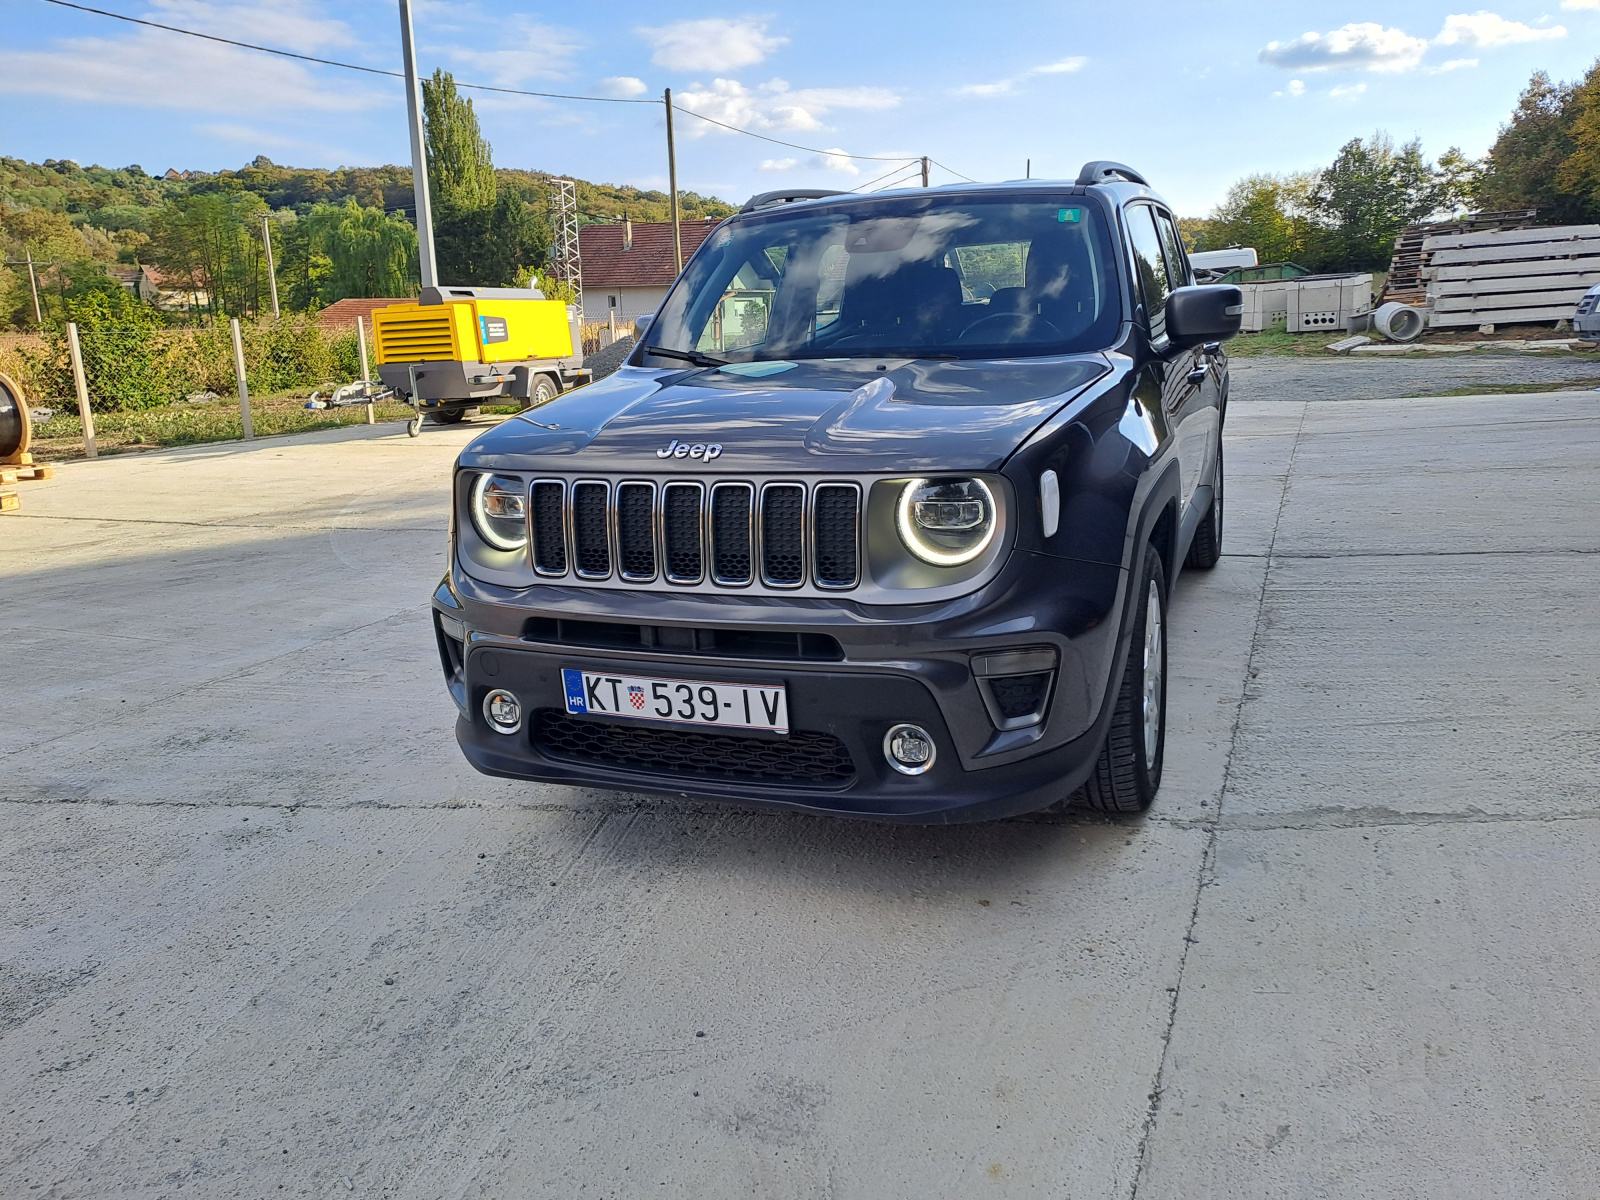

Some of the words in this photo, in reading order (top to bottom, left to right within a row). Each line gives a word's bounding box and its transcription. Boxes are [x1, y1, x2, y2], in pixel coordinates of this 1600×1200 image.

[656, 439, 723, 463] Jeep
[569, 695, 584, 707] HR
[585, 675, 622, 712] KT
